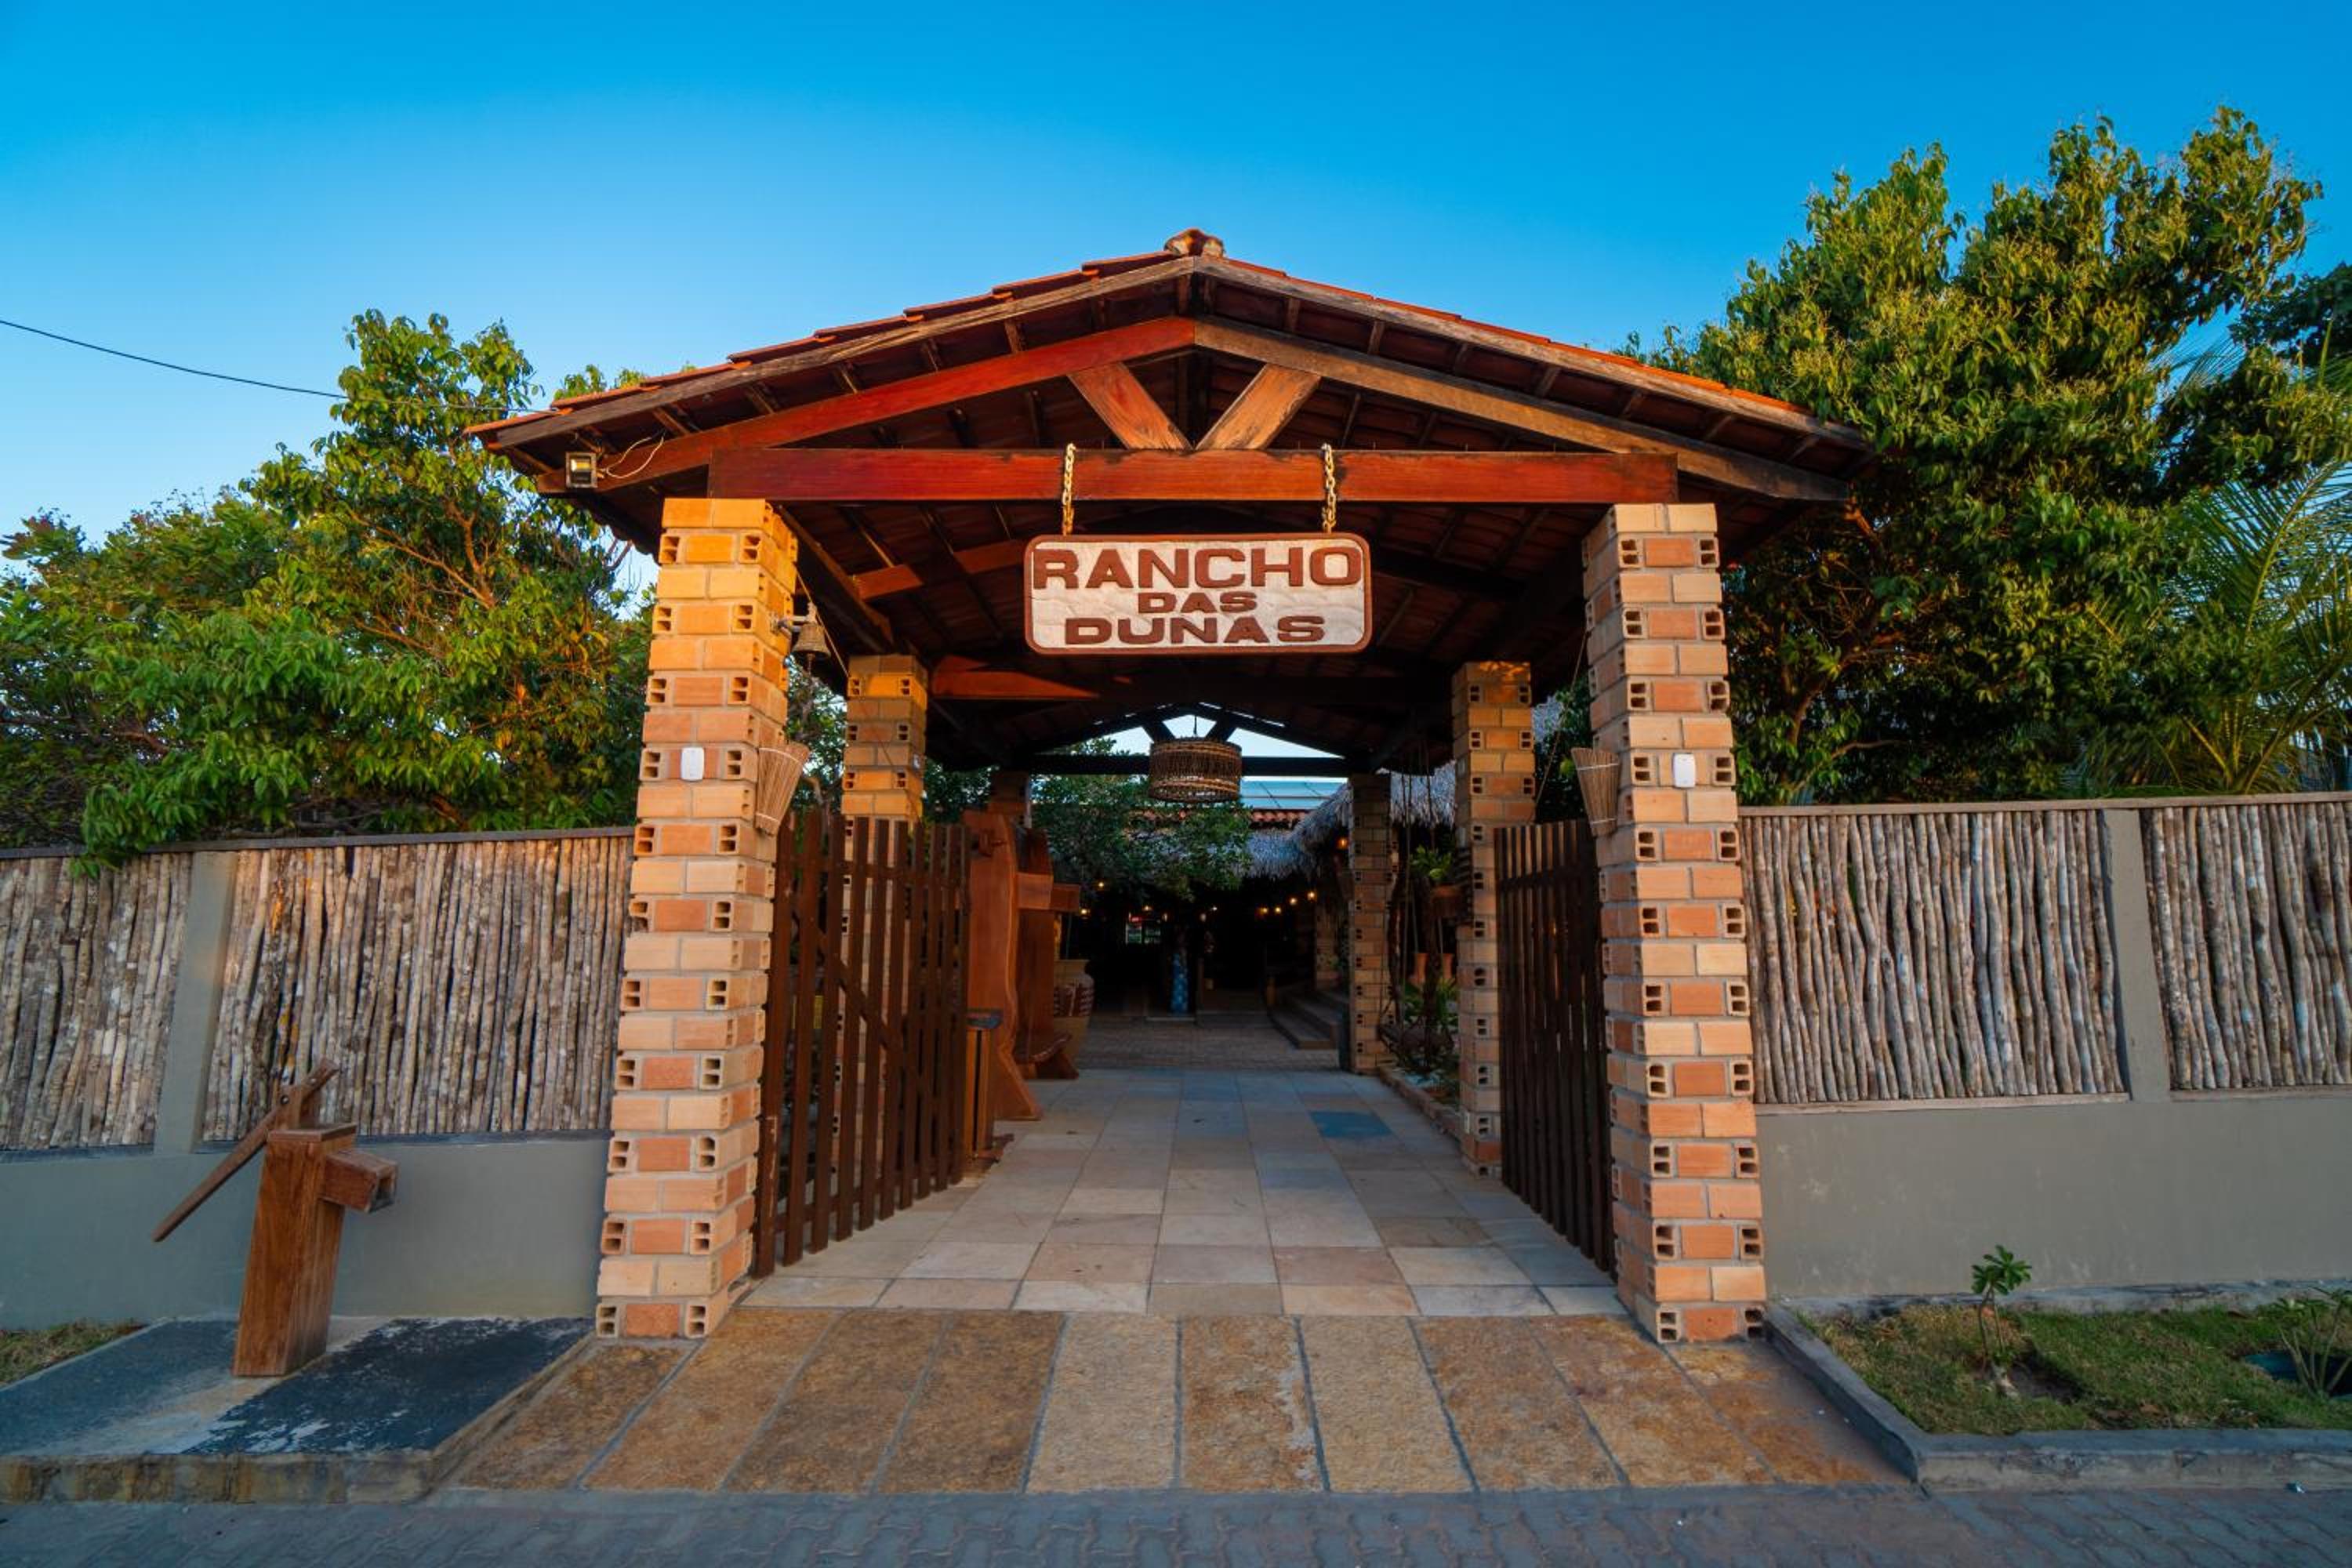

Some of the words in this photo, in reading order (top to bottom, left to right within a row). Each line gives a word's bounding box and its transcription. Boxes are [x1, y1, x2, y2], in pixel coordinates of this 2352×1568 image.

[1033, 547, 1361, 589] RANCHO
[1138, 591, 1258, 613] DAS
[1065, 615, 1325, 644] DUNAS
